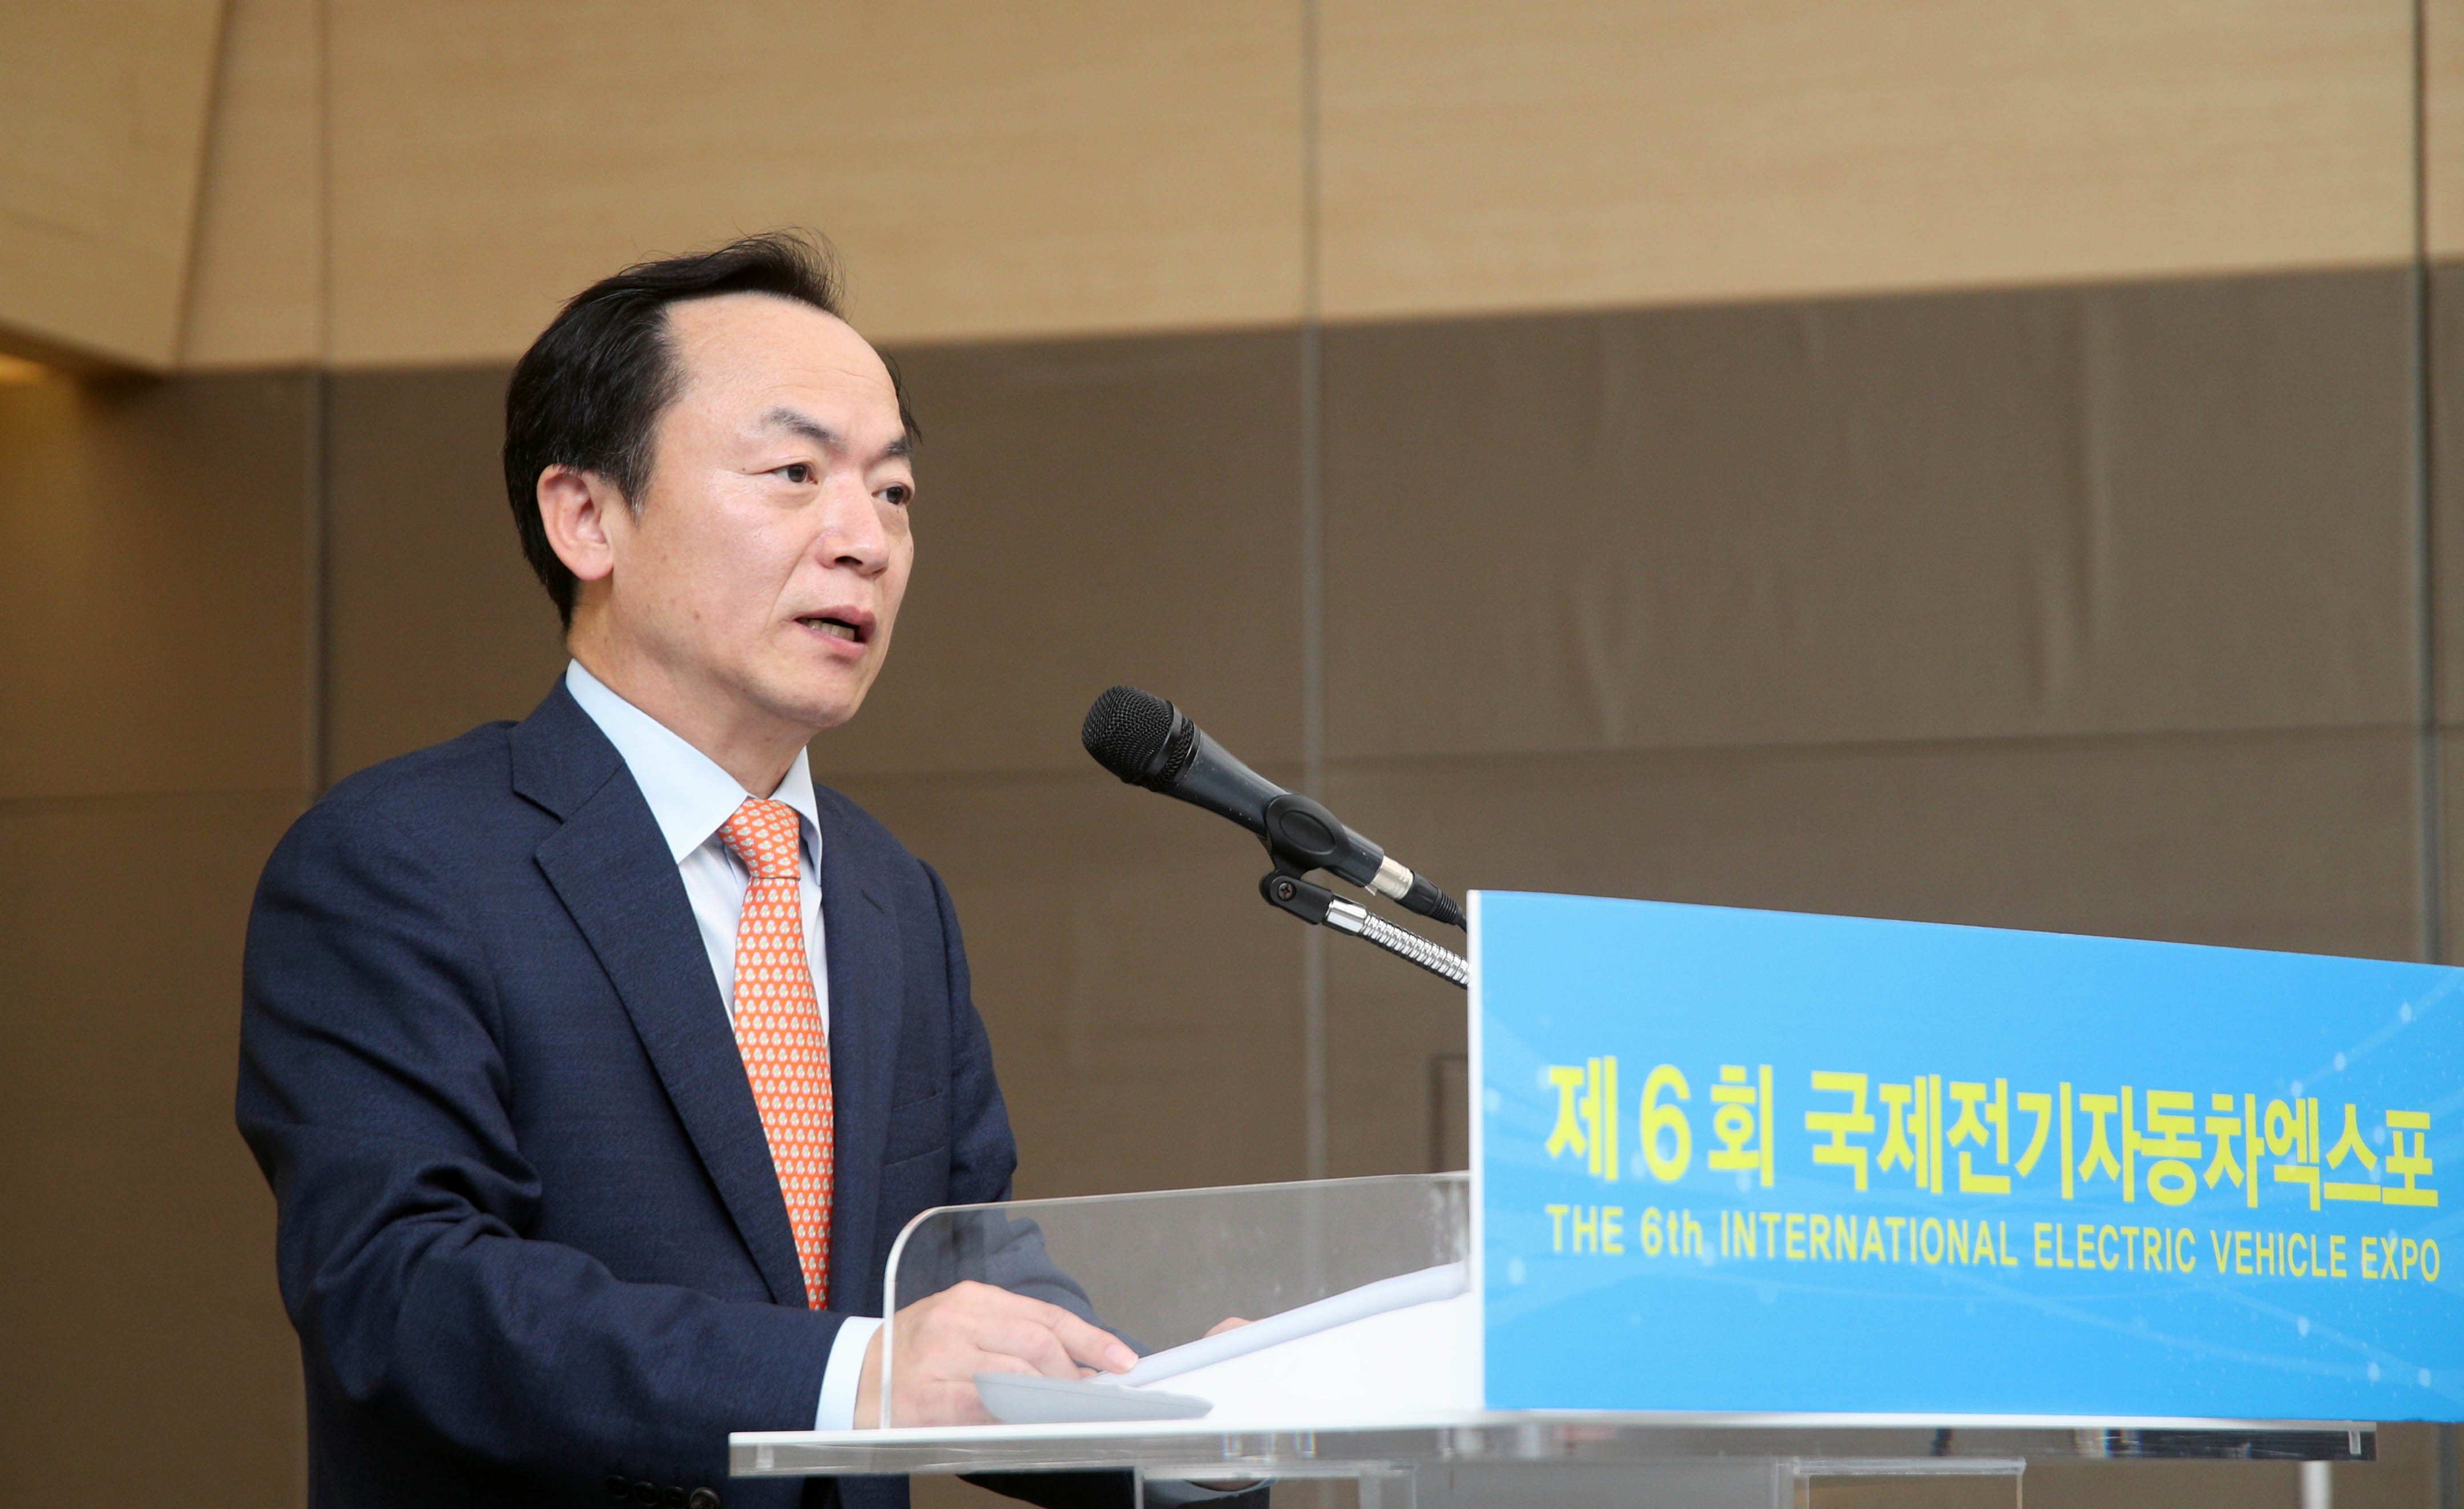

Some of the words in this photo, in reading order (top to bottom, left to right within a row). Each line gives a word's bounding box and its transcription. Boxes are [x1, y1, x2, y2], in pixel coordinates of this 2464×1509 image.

[1805, 1070, 2440, 1212] 국제전기자동차엑스포
[1546, 1204, 1624, 1254] THE
[1642, 1207, 1703, 1256] 6th
[1721, 1211, 2018, 1266] INTERNATIONAL
[2034, 1222, 2196, 1273] ELECTRIC
[2211, 1230, 2348, 1279] VEHICLE
[2361, 1236, 2441, 1283] EXPO
